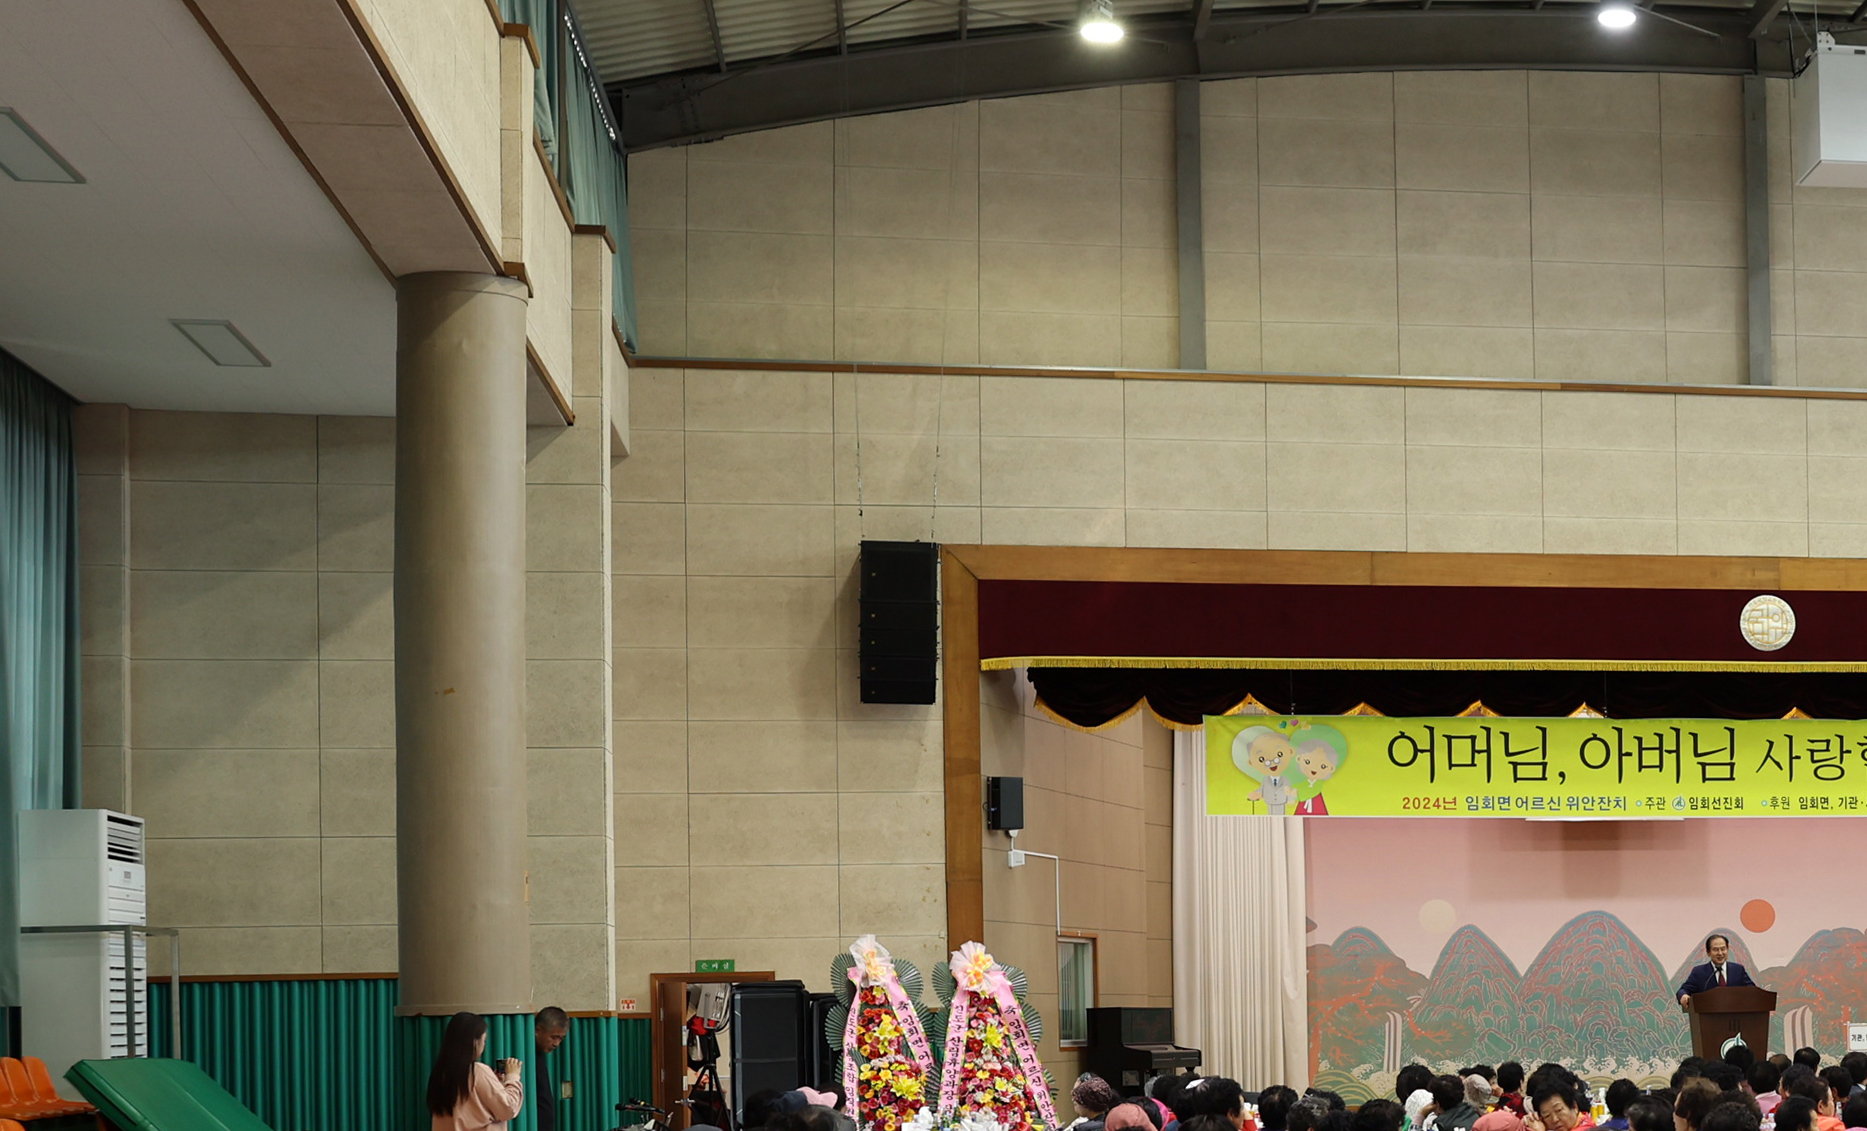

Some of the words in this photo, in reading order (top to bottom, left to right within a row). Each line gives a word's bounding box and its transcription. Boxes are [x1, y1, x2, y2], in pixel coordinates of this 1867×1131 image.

[1387, 724, 1566, 785] 어머님,
[1579, 725, 1736, 785] 아버님
[1401, 796, 1458, 811] 2024년
[1465, 796, 1512, 811] 임회면
[1515, 796, 1562, 811] 어르신
[1566, 796, 1628, 811] 위안잔치
[1644, 796, 1667, 811] 주관
[1688, 796, 1745, 810] 임회선진회
[1769, 796, 1791, 810] 후원
[1798, 796, 1834, 810] 임회면,
[902, 1014, 924, 1048] 임회면
[951, 1004, 965, 1033] 진도군
[1009, 1018, 1029, 1051] 임회면
[1022, 1054, 1042, 1087] 어르신
